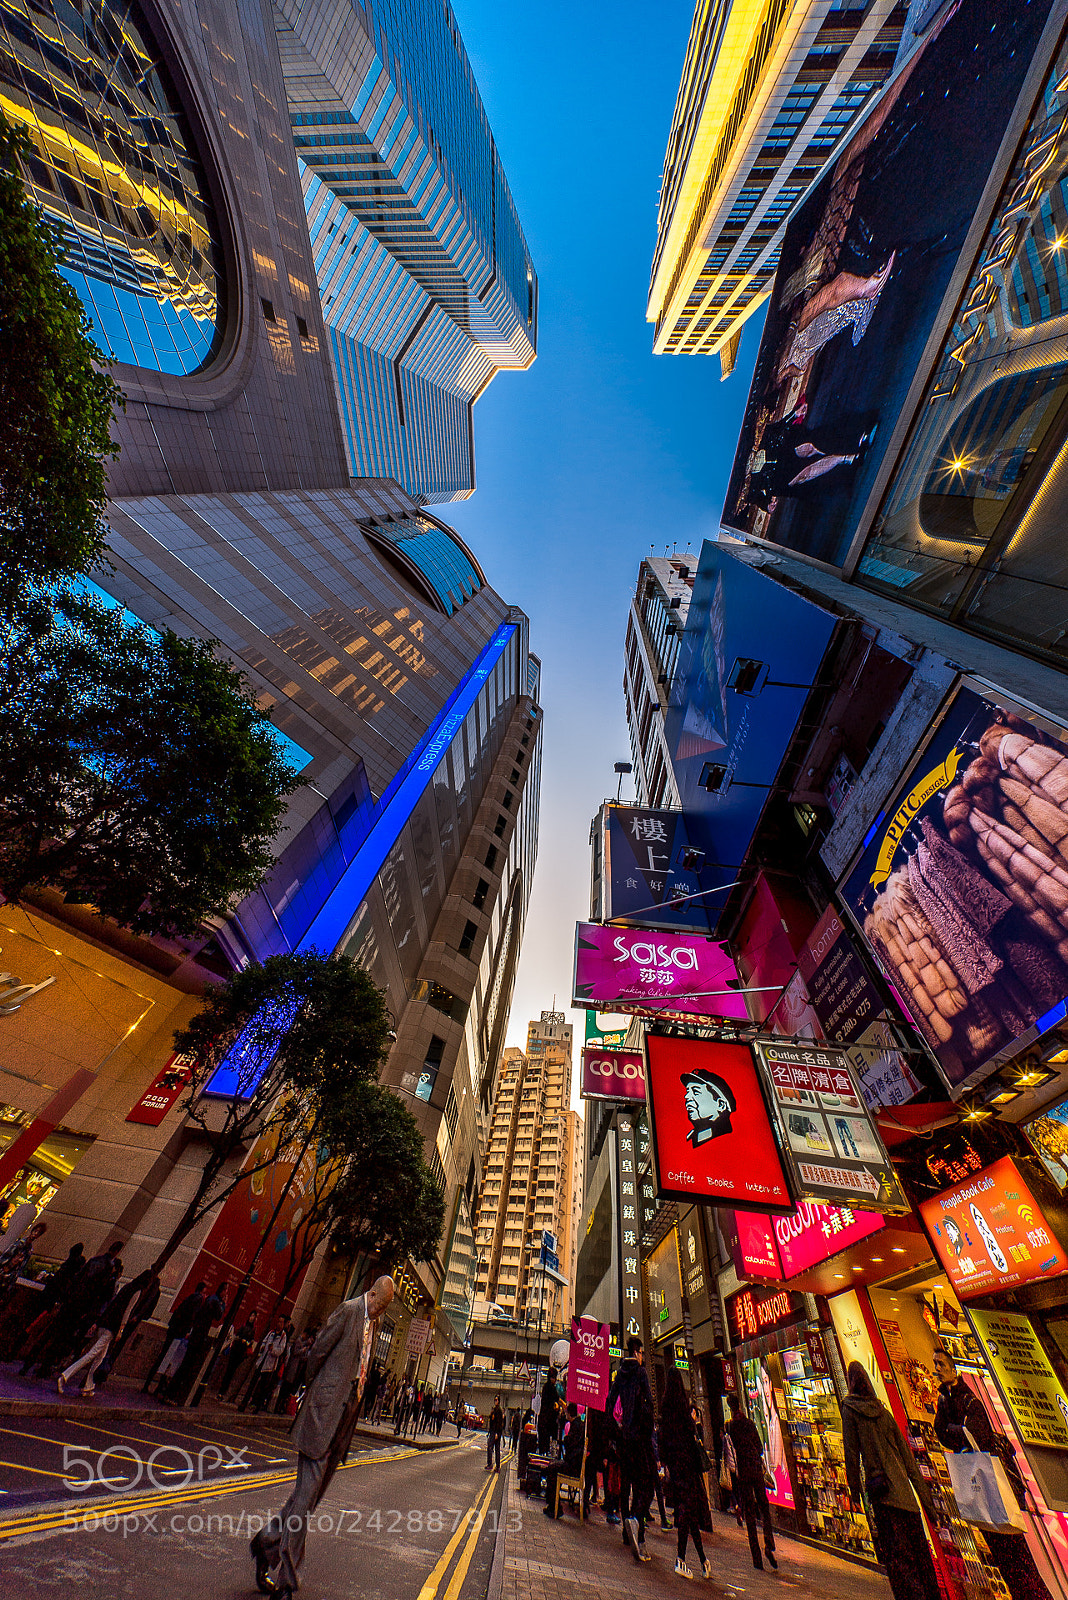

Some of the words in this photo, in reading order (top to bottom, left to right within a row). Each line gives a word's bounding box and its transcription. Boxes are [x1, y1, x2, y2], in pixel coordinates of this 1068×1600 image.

[418, 712, 464, 771] PizzaExpress
[920, 775, 946, 801] DESIGN
[886, 792, 922, 845] PITC
[629, 816, 675, 874] 樓上
[886, 844, 896, 860] FUR
[810, 916, 840, 961] home
[640, 968, 674, 985] 莎莎
[769, 1049, 800, 1061] Outlet
[773, 1065, 850, 1090] 名牌清倉
[140, 1100, 166, 1109] FORUM
[145, 1094, 170, 1103] FOOD
[667, 1171, 695, 1185] Coffee
[706, 1176, 735, 1189] Books
[879, 1171, 893, 1197] 2/F
[939, 1187, 963, 1211] People
[960, 1183, 980, 1203] Book
[977, 1176, 996, 1192] Cafe
[1005, 1191, 1020, 1200] Scan
[821, 1207, 856, 1239] 卡萊美
[995, 1225, 1016, 1235] Printing
[1027, 1227, 1051, 1248] 奶粉
[744, 1255, 777, 1267] colourmix
[1008, 1242, 1032, 1263] 圖書
[1039, 1254, 1060, 1272] Internet
[757, 1291, 791, 1326] BONJOUR
